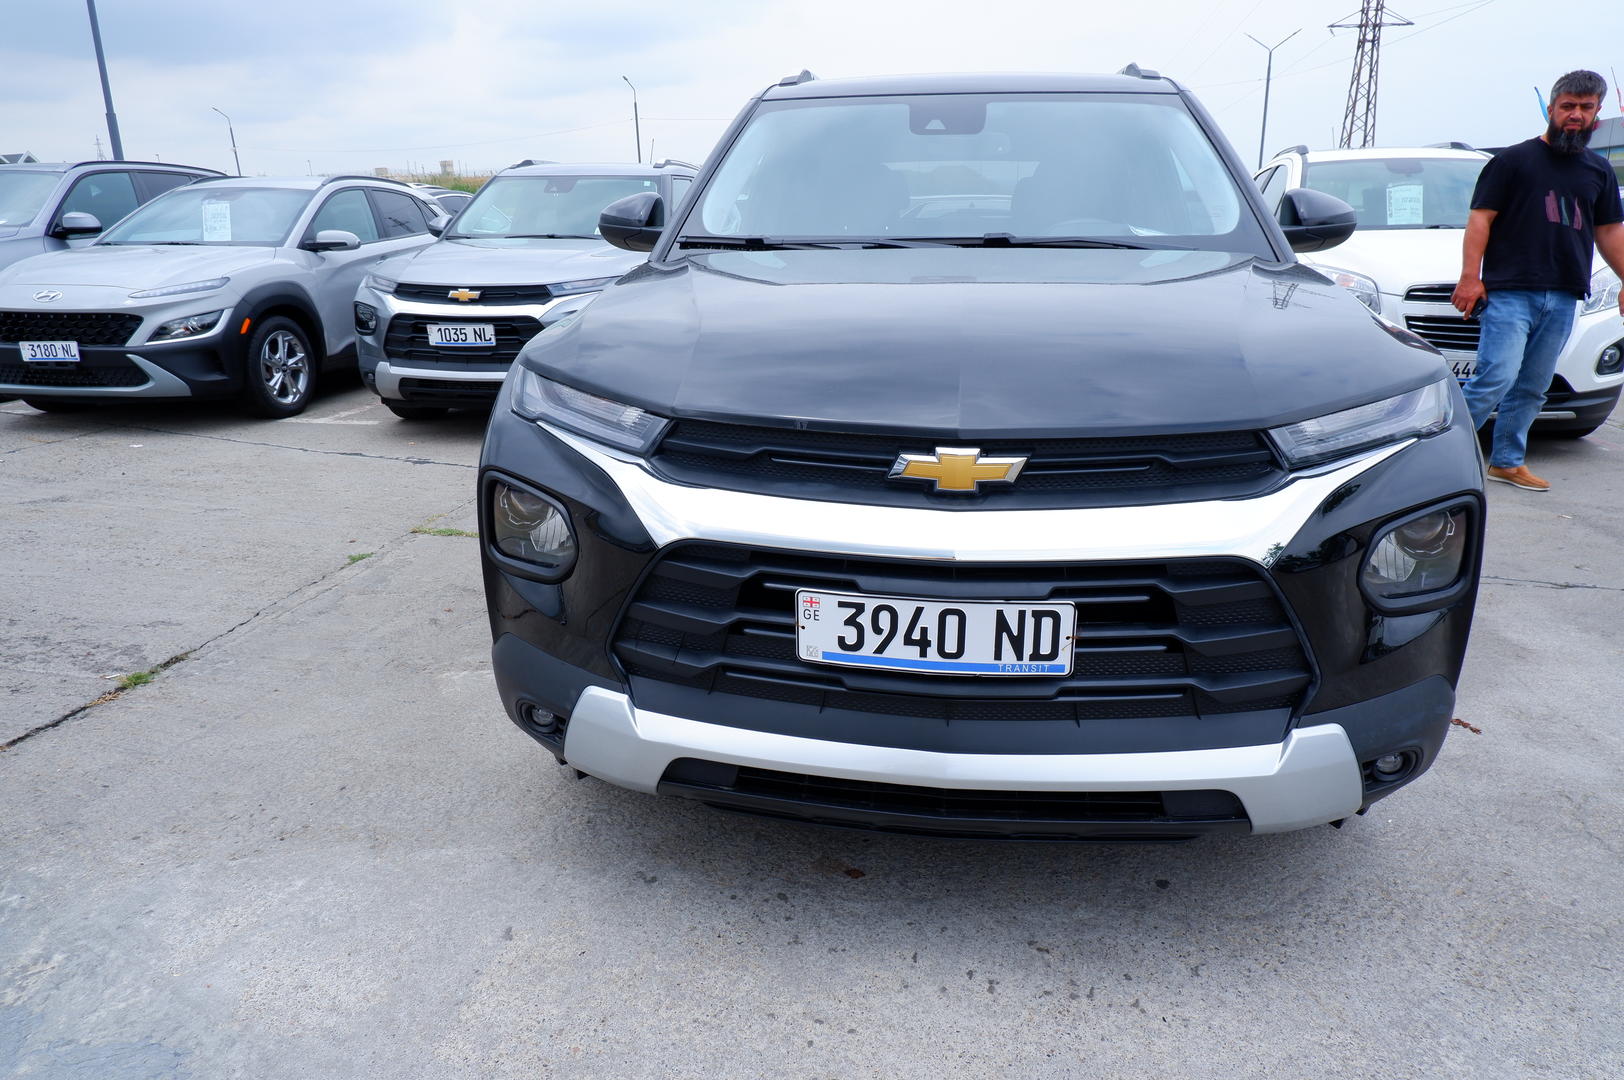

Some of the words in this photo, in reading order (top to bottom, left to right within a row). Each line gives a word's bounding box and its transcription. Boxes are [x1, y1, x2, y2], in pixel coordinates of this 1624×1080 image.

[437, 327, 468, 342] 1035
[473, 327, 492, 342] NL
[28, 343, 58, 358] 3180
[61, 343, 76, 358] NL
[803, 608, 820, 621] GE
[837, 600, 967, 660] 3940
[993, 608, 1062, 662] ND
[998, 663, 1050, 673] TRANSIT
